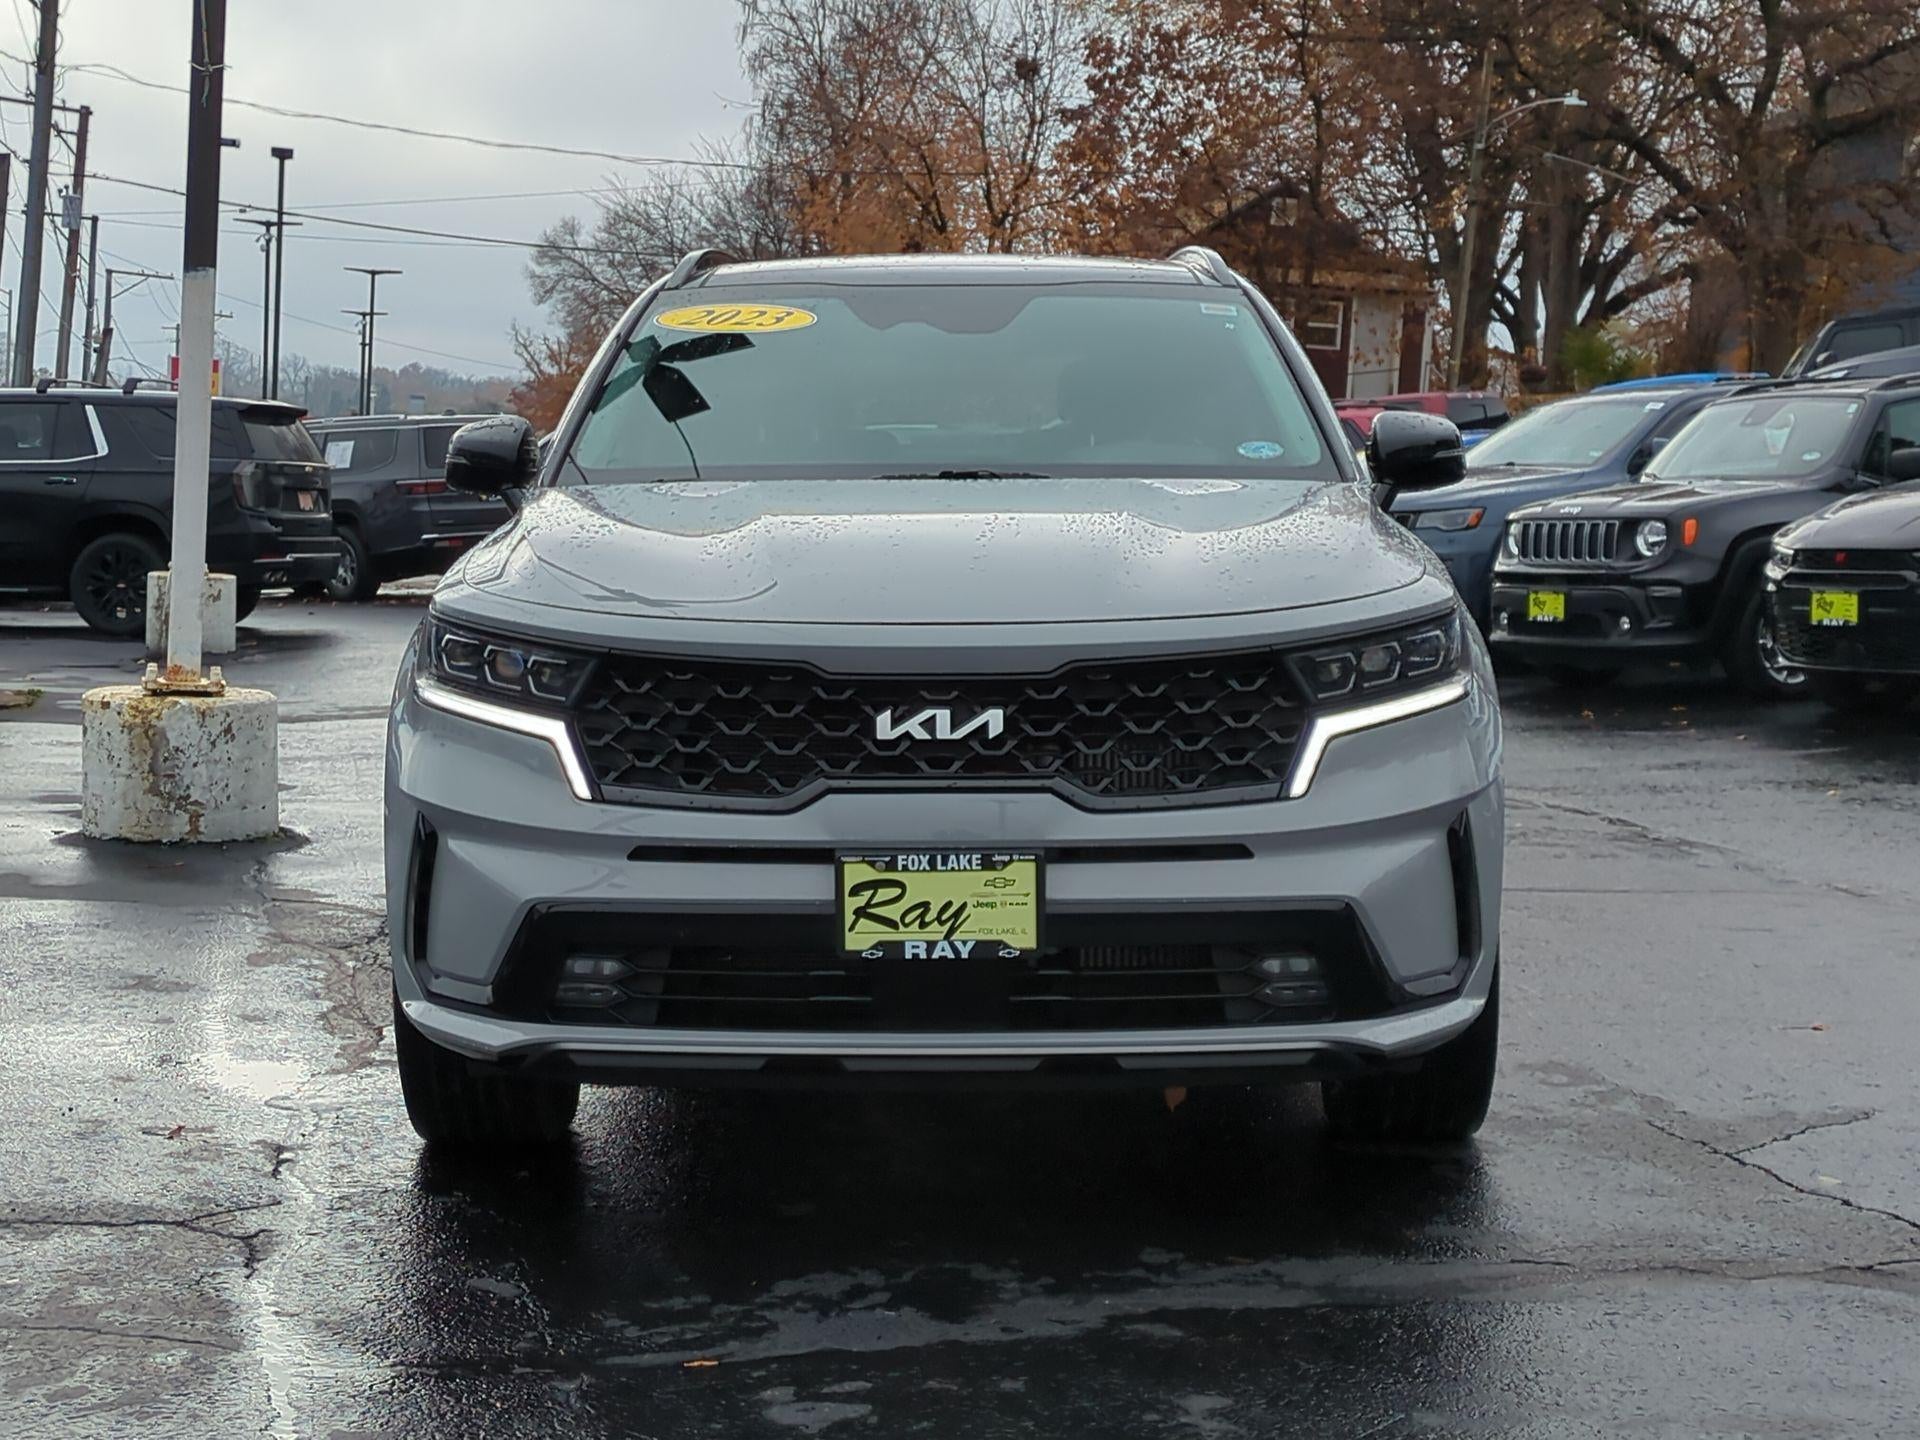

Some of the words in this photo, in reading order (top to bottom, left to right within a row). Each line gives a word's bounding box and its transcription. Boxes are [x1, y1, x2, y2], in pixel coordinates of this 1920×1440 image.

[678, 309, 796, 327] 2023
[876, 709, 1004, 740] KIA
[897, 855, 930, 871] FOX
[937, 854, 982, 870] LAKE
[848, 878, 972, 940] Ray
[972, 900, 997, 909] Jeep
[904, 941, 977, 959] RAY
